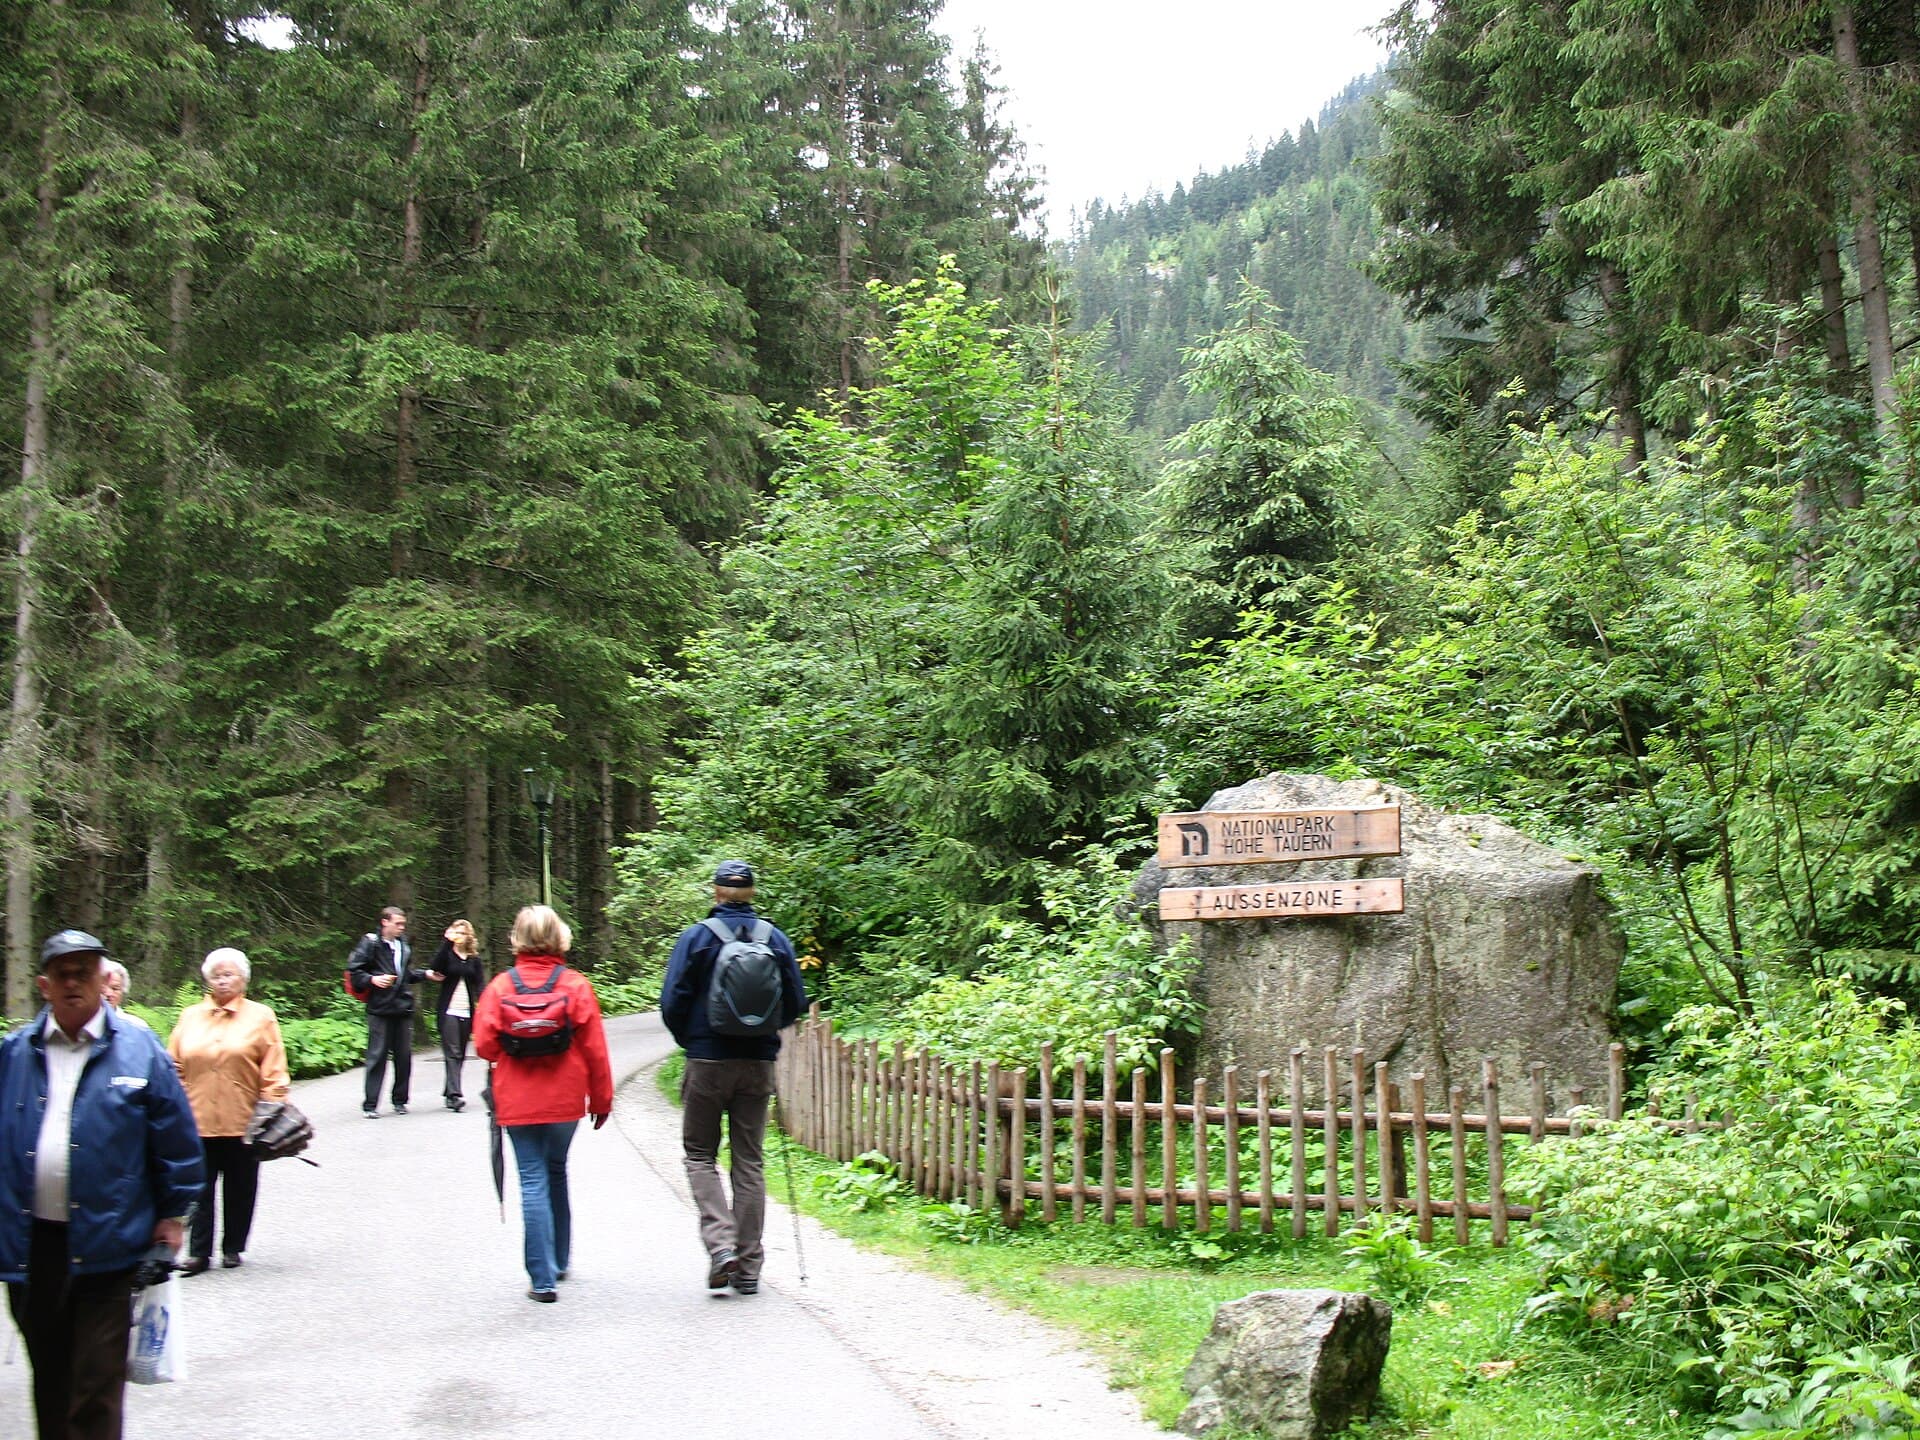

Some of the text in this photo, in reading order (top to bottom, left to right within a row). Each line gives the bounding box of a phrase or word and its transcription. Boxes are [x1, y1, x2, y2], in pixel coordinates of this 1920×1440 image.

[1221, 816, 1335, 836] NATIONALPARK
[1223, 834, 1333, 854] HOHE TAUERN
[1213, 889, 1344, 911] AUSSENZONE
